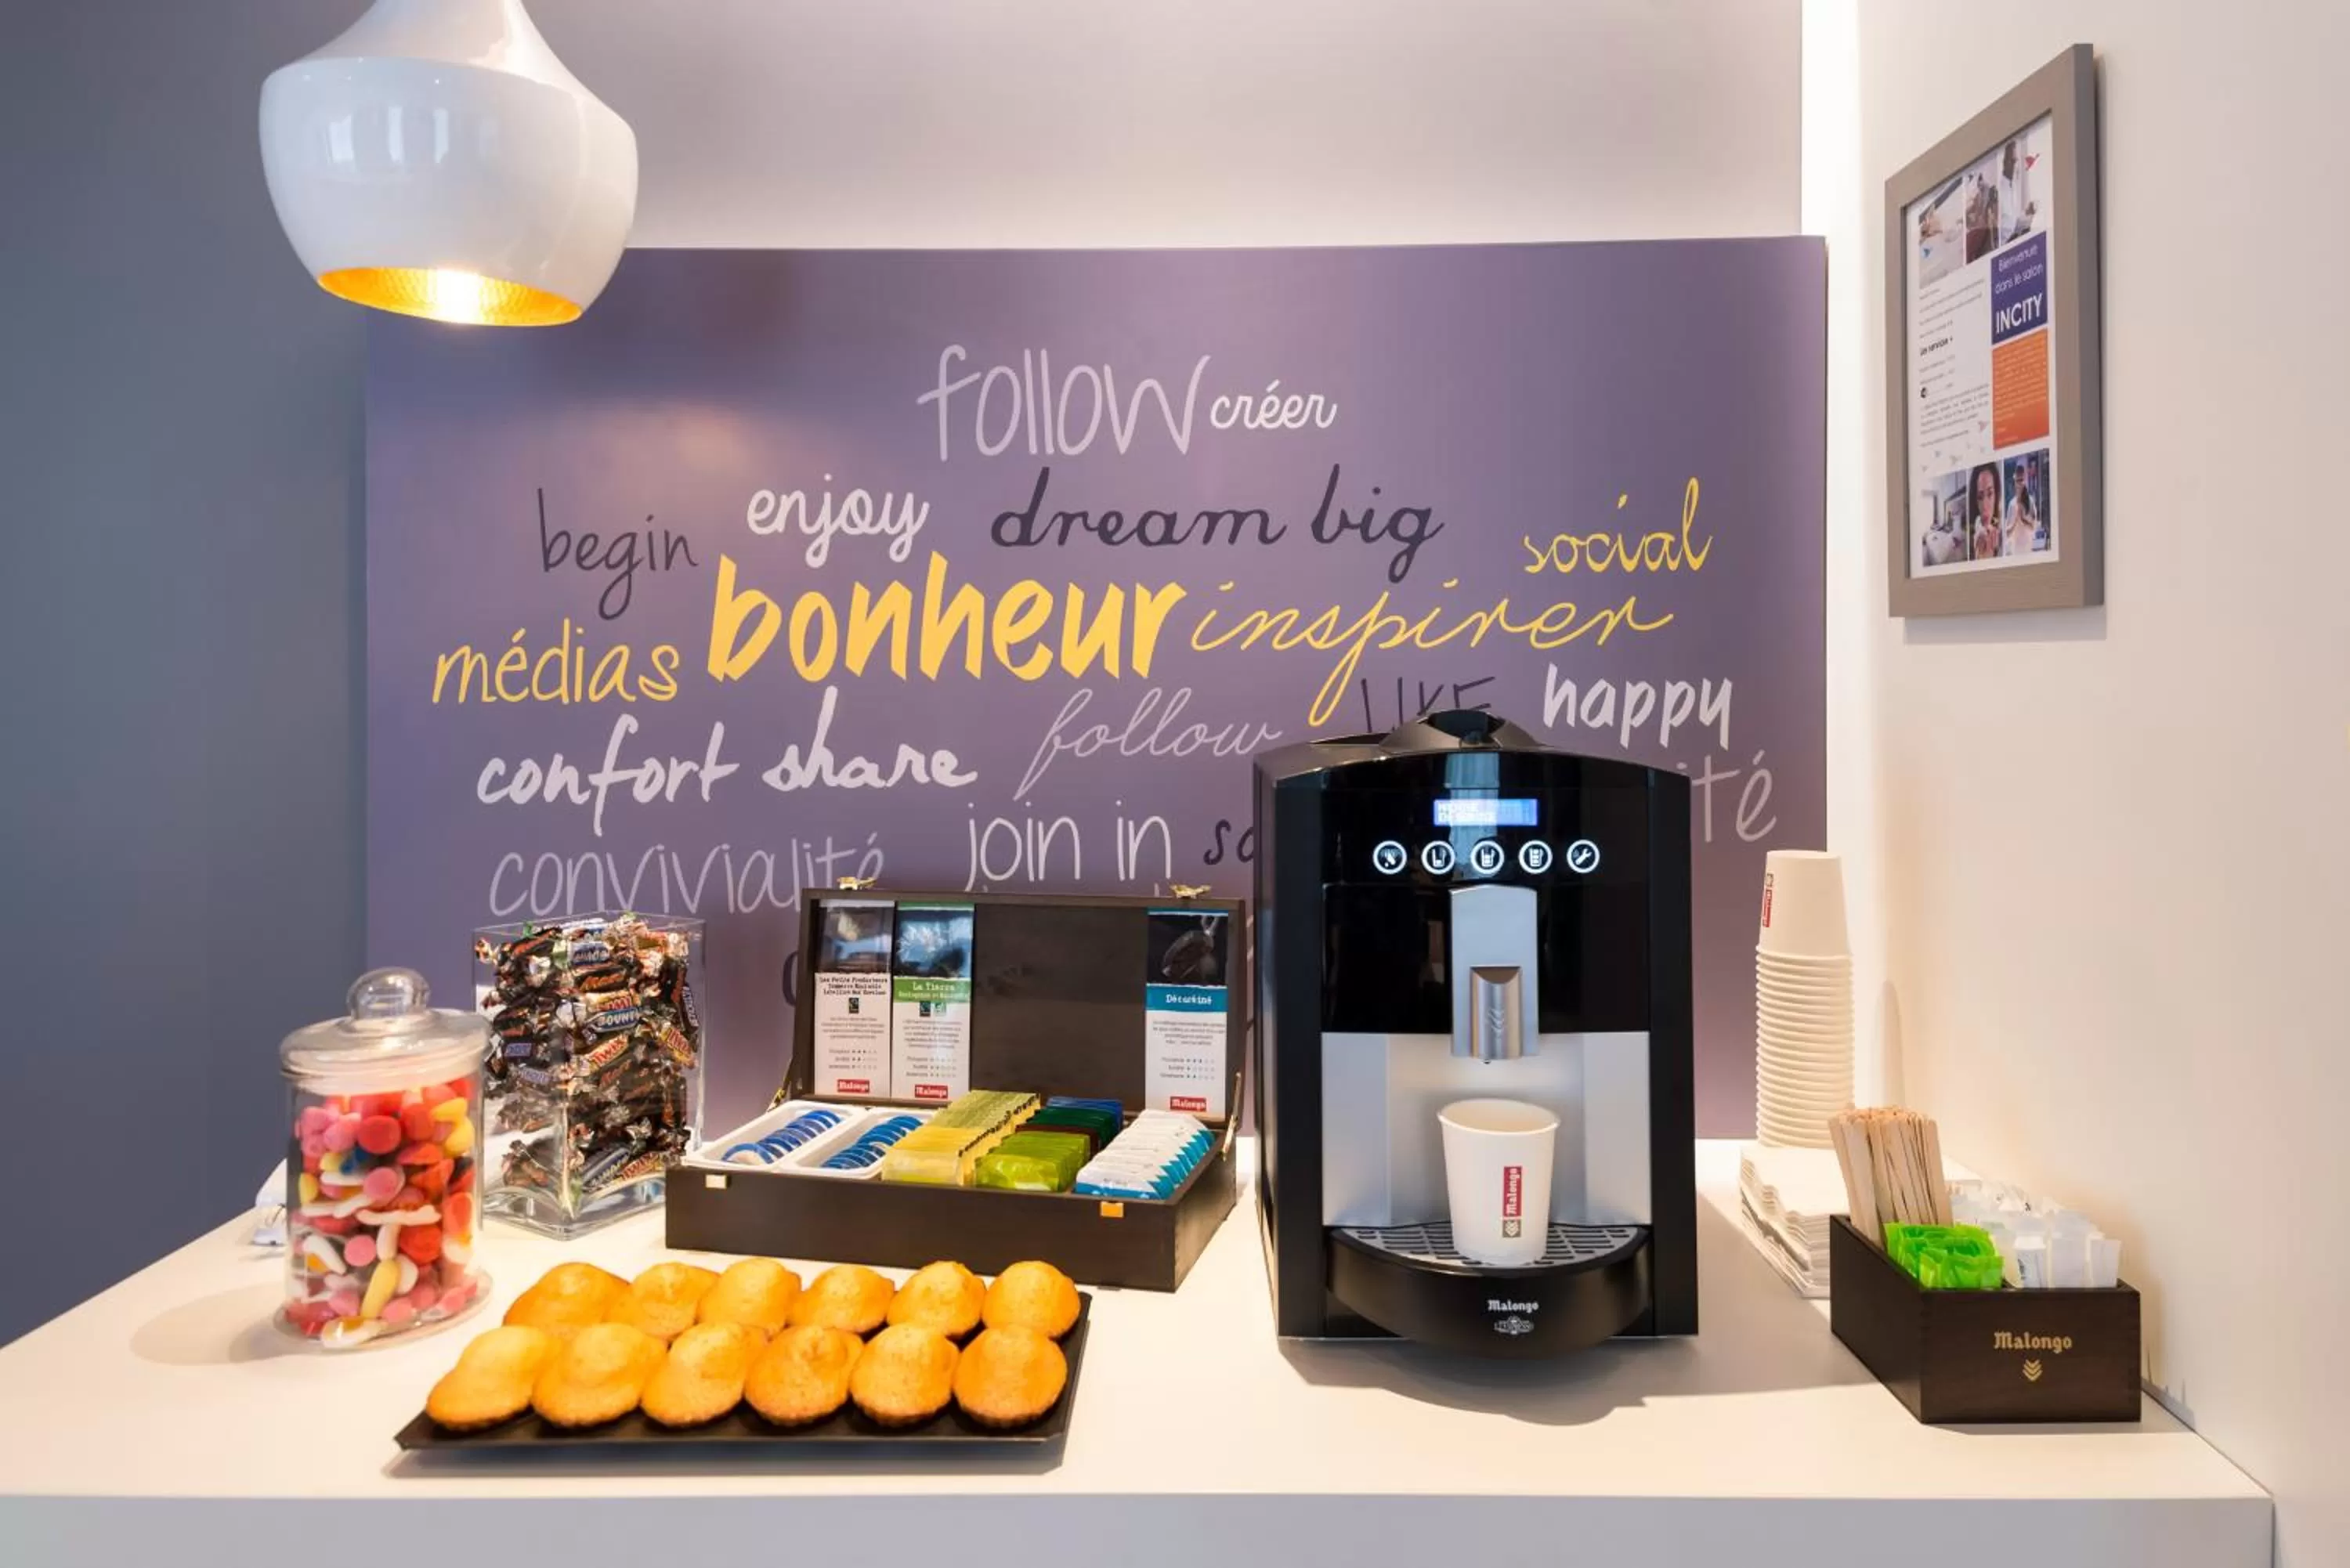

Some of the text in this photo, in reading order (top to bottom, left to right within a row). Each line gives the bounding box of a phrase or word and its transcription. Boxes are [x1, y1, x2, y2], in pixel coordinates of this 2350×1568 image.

[1995, 293, 2043, 334] INCITY
[1209, 379, 1338, 430] créer
[537, 487, 700, 621] begin
[747, 473, 929, 568] enjoy
[991, 464, 1444, 583] dream big
[1524, 477, 1712, 573] social
[432, 618, 679, 704] médias
[707, 551, 1188, 681] bonheur
[1191, 578, 1674, 726] inspirer
[1012, 687, 1282, 802] follow
[1543, 663, 1732, 751] happy
[476, 685, 978, 836] confort share
[964, 800, 1172, 891] join in
[1505, 1168, 1520, 1214] Malongo
[1487, 1299, 1539, 1313] Malongo
[1994, 1331, 2073, 1354] Malongo
